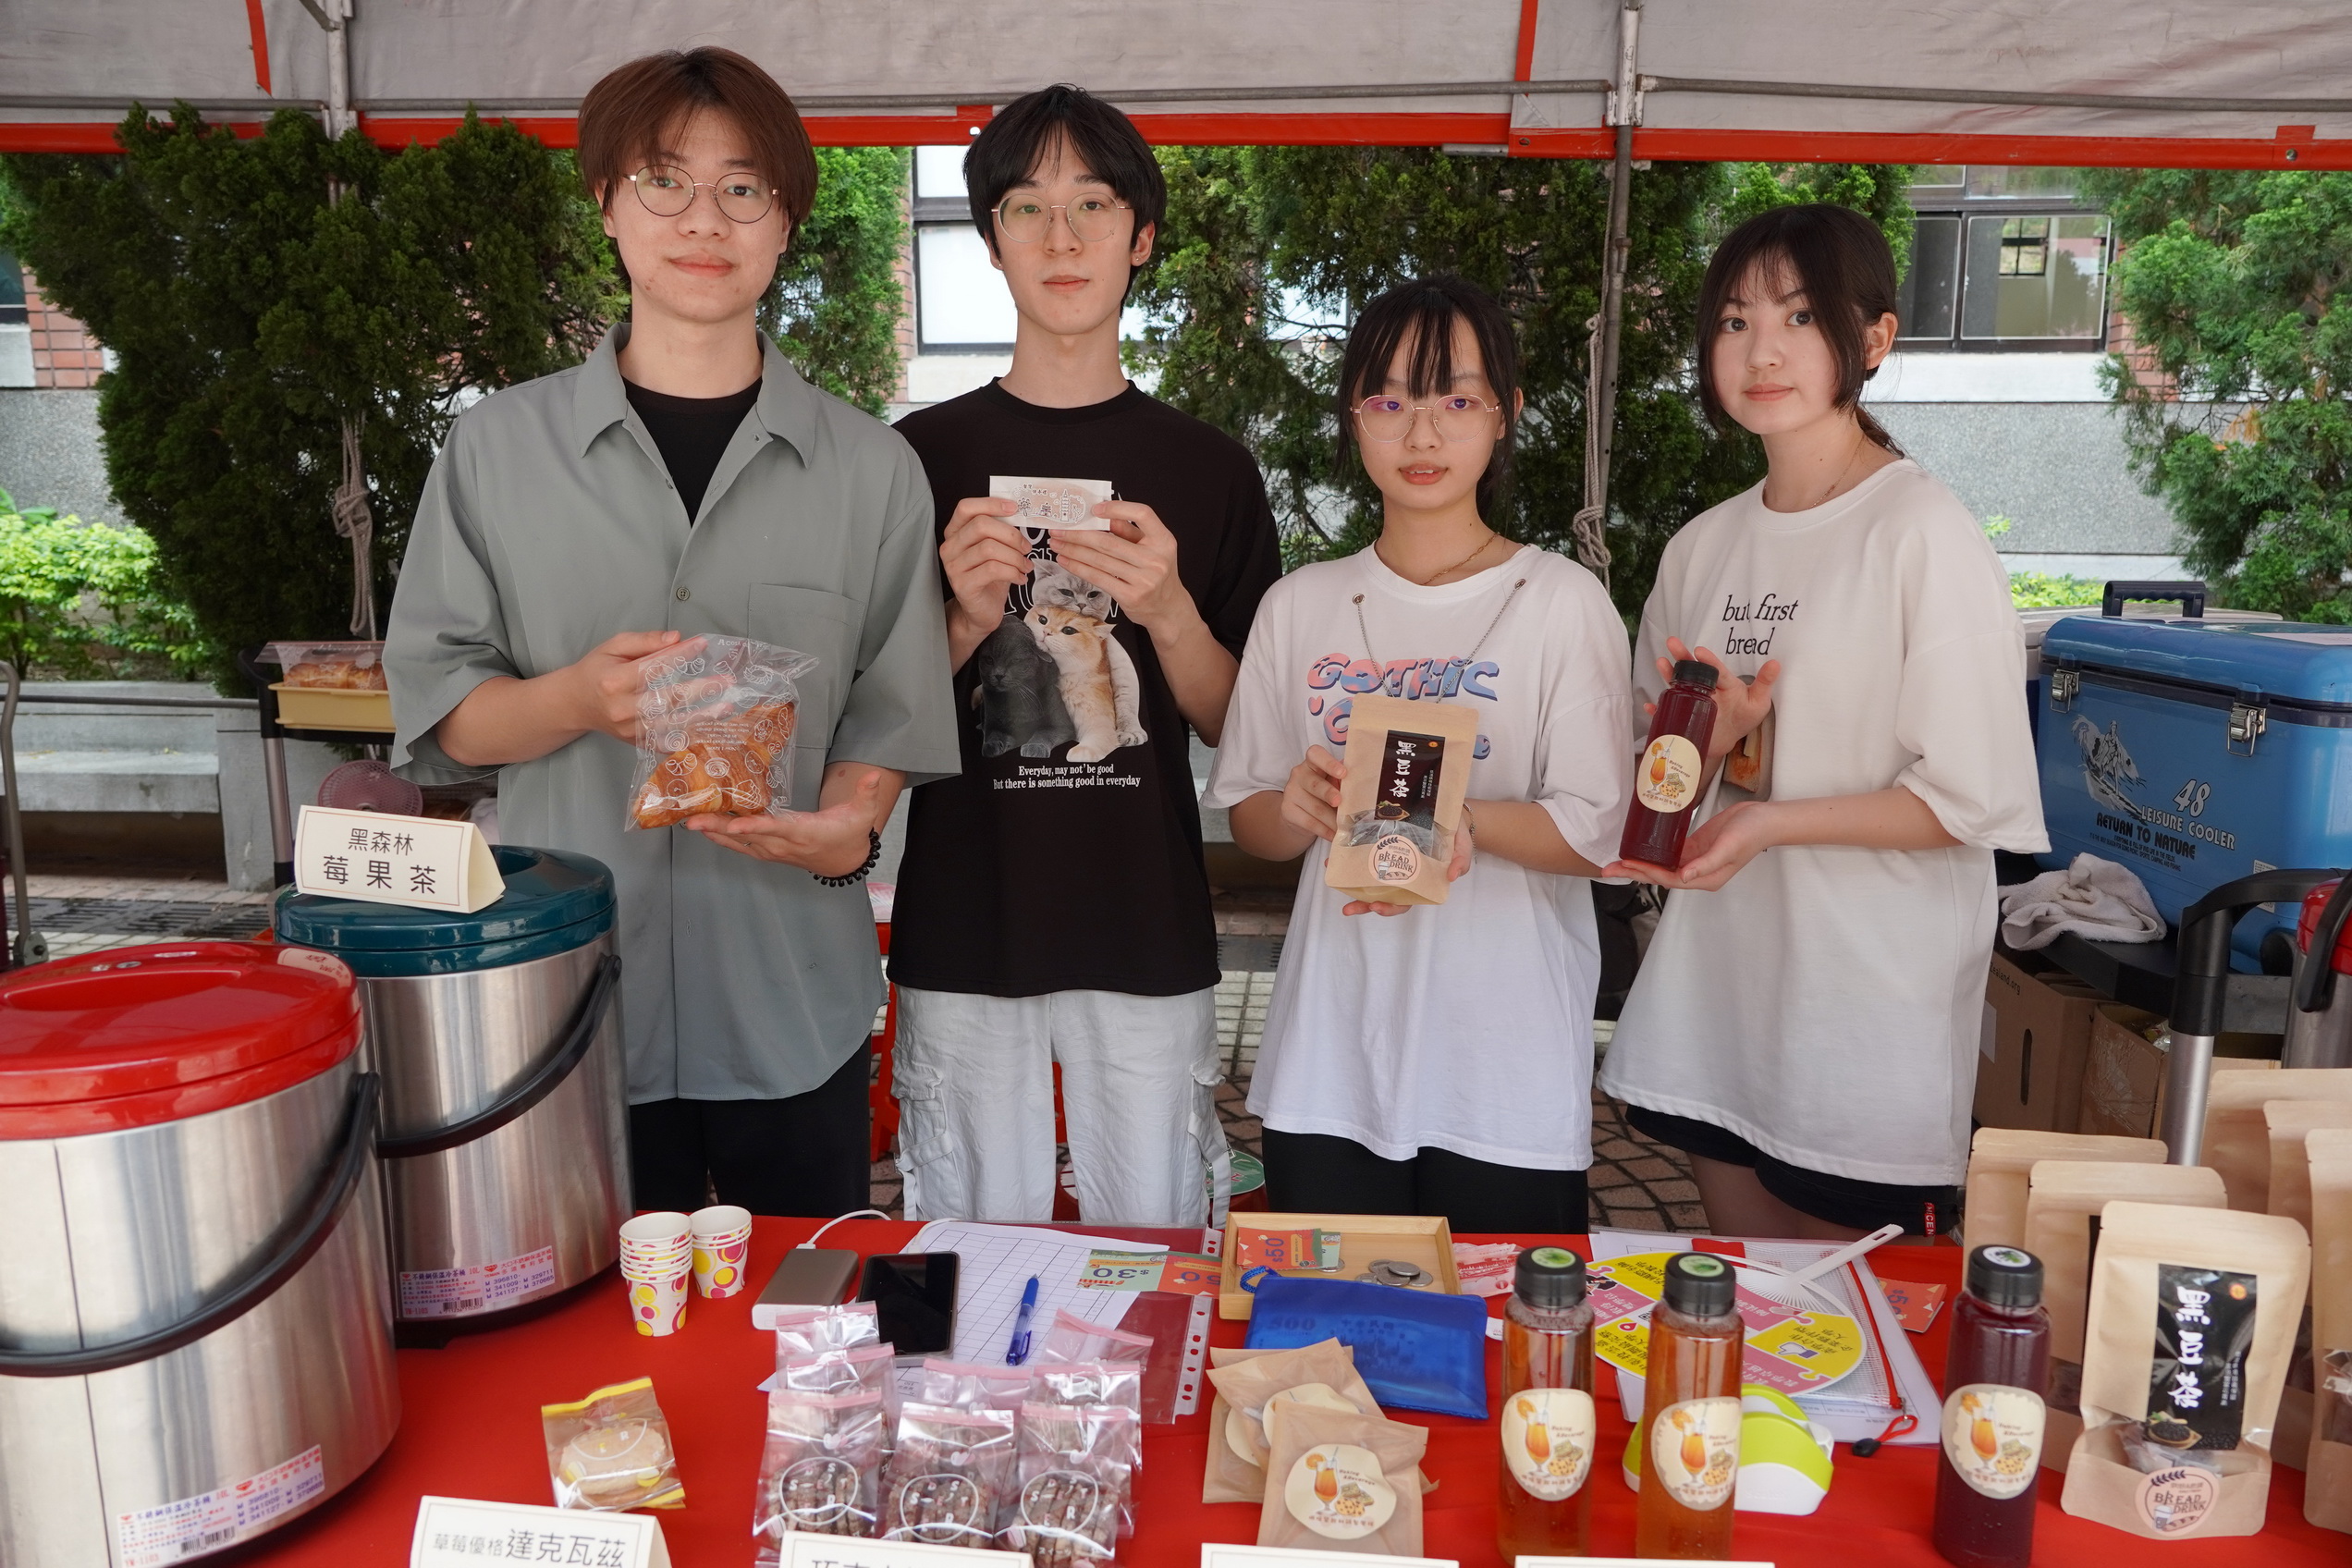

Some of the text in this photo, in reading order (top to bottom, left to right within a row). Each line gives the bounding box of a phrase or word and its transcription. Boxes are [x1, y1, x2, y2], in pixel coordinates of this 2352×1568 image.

[1754, 594, 1799, 620] first
[1725, 627, 1775, 655] bread
[993, 775, 1141, 790] But there is something good in everyday
[1018, 766, 1053, 777] Everyday,
[1054, 766, 1068, 777] may
[1086, 765, 1096, 774] be
[1096, 764, 1114, 776] good
[1389, 741, 1416, 798] 黑豆茶
[2173, 778, 2211, 817] 48
[348, 827, 414, 856] 黑森林
[2096, 812, 2196, 860] RETURN TO NATURE
[2141, 805, 2236, 851] LEISURE COOLER
[1378, 851, 1410, 864] BREAD
[1390, 861, 1414, 873] DRINK
[323, 855, 436, 895] 莓果茶
[1092, 1268, 1150, 1280] $30
[2167, 1286, 2211, 1408] 黑豆茶
[2153, 1490, 2202, 1505] BREAD
[2174, 1500, 2207, 1514] DRINK
